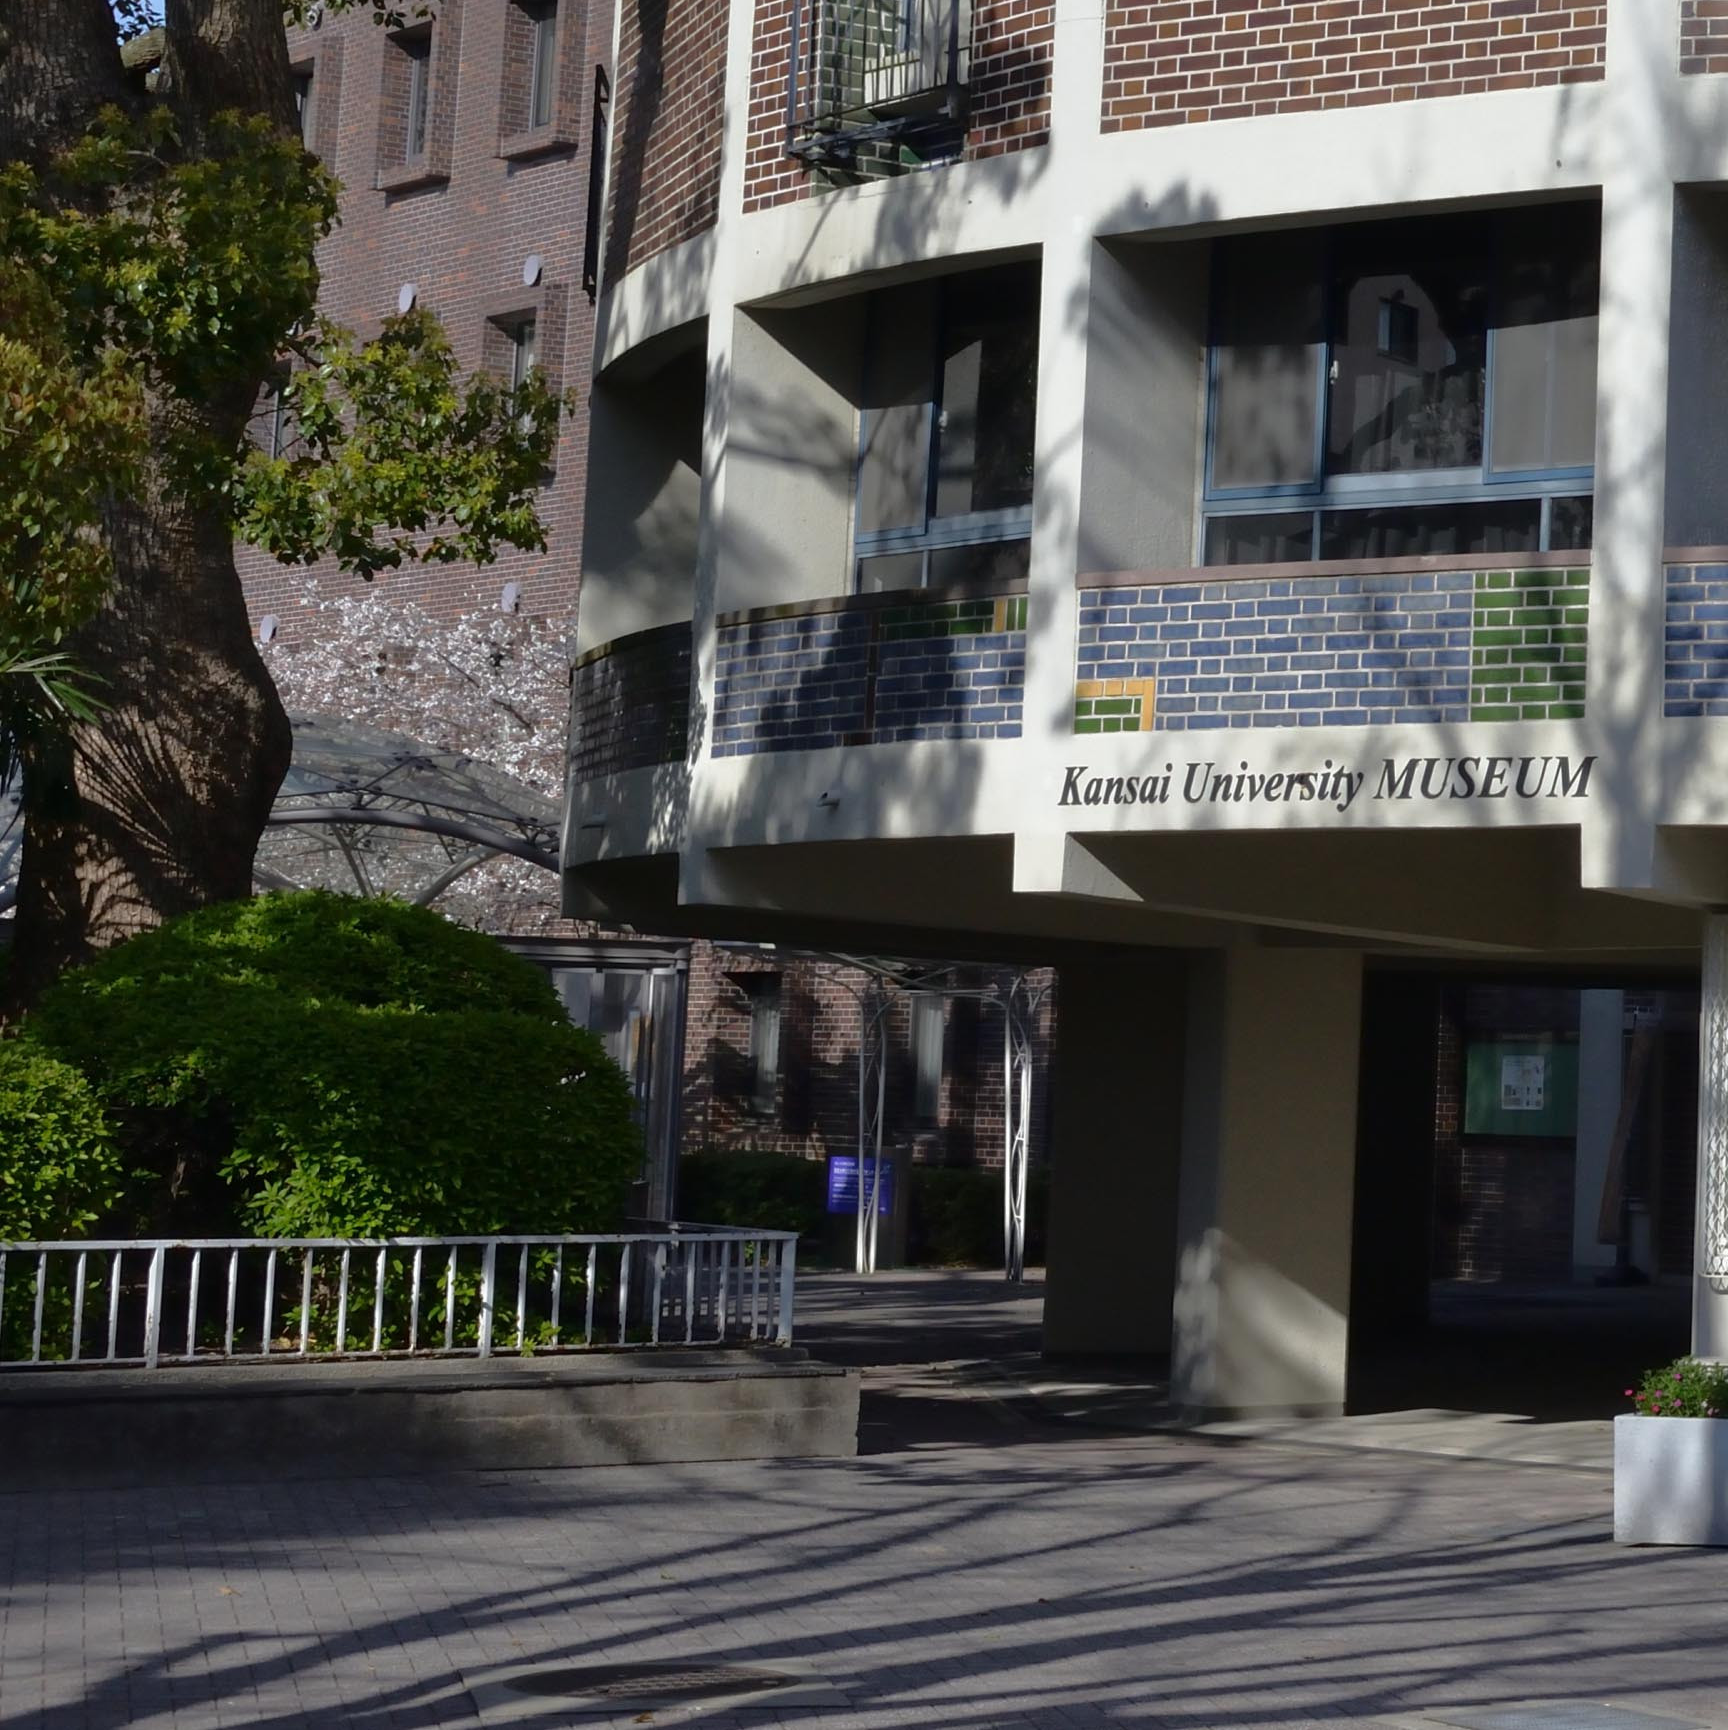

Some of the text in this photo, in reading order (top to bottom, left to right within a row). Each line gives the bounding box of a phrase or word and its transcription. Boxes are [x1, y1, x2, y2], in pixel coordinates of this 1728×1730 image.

[1058, 755, 1598, 813] Kansai University MUSEUM
